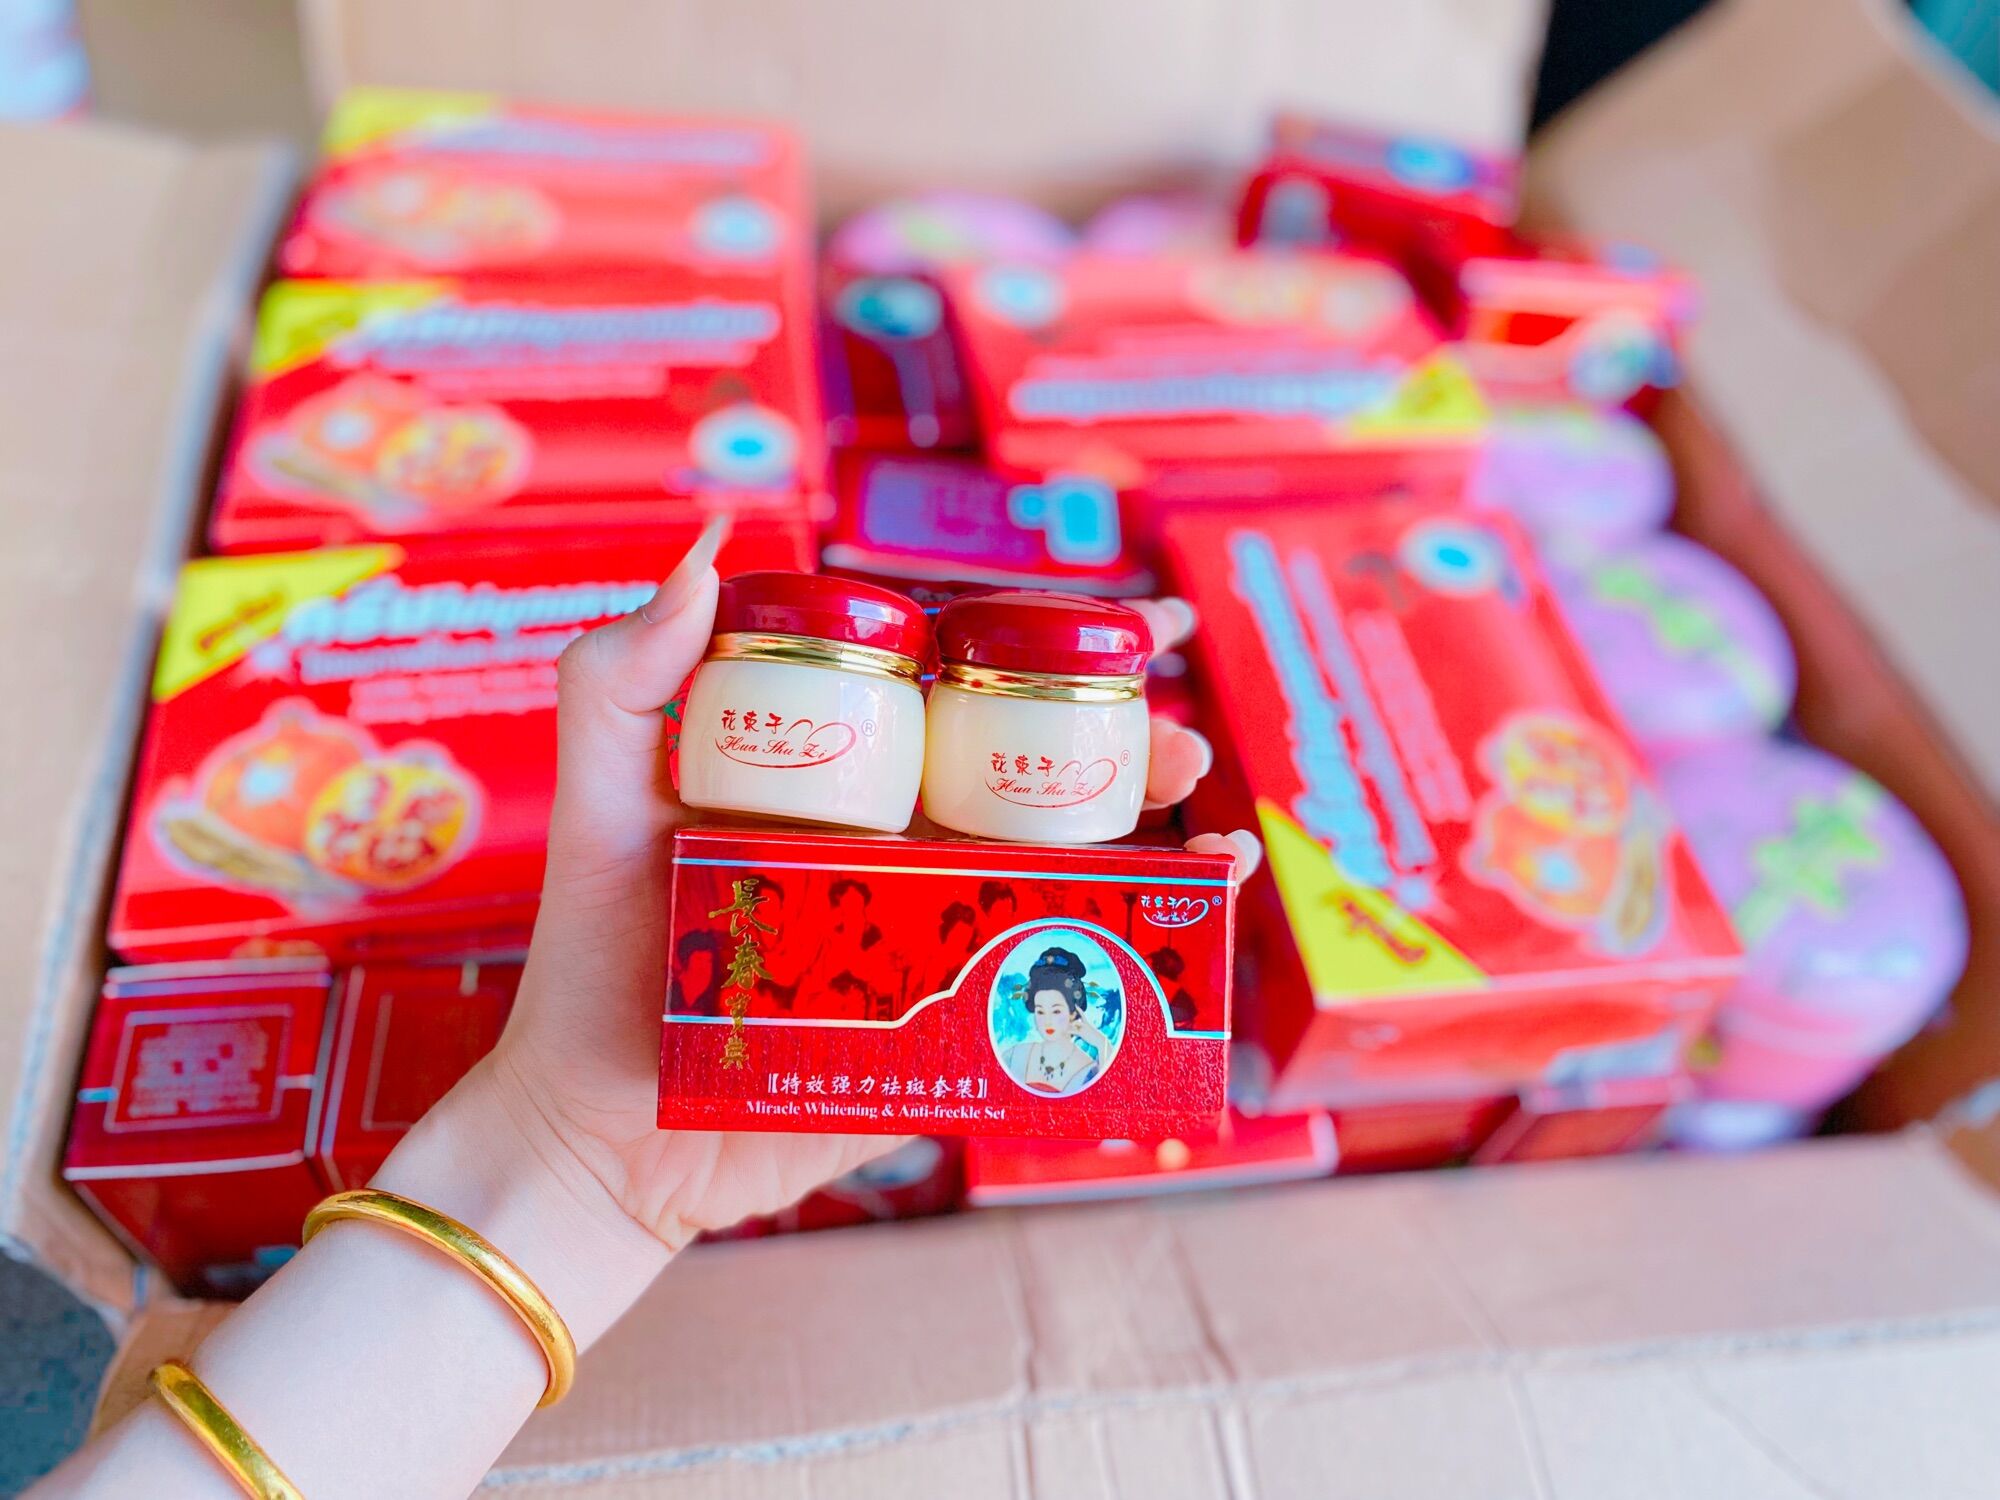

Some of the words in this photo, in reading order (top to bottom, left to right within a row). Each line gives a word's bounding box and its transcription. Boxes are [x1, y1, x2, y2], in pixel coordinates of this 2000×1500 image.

[720, 735, 758, 753] Hua
[762, 739, 795, 756] Shu
[798, 742, 828, 759] Zi
[992, 777, 1033, 795] Hua
[1036, 781, 1067, 797] Shu
[1070, 782, 1096, 797] Zi
[746, 1100, 801, 1116] Miracle
[804, 1102, 878, 1119] Whitening
[881, 1104, 895, 1118] &
[899, 1103, 981, 1120] Anti-freckle
[983, 1106, 1006, 1120] Set
